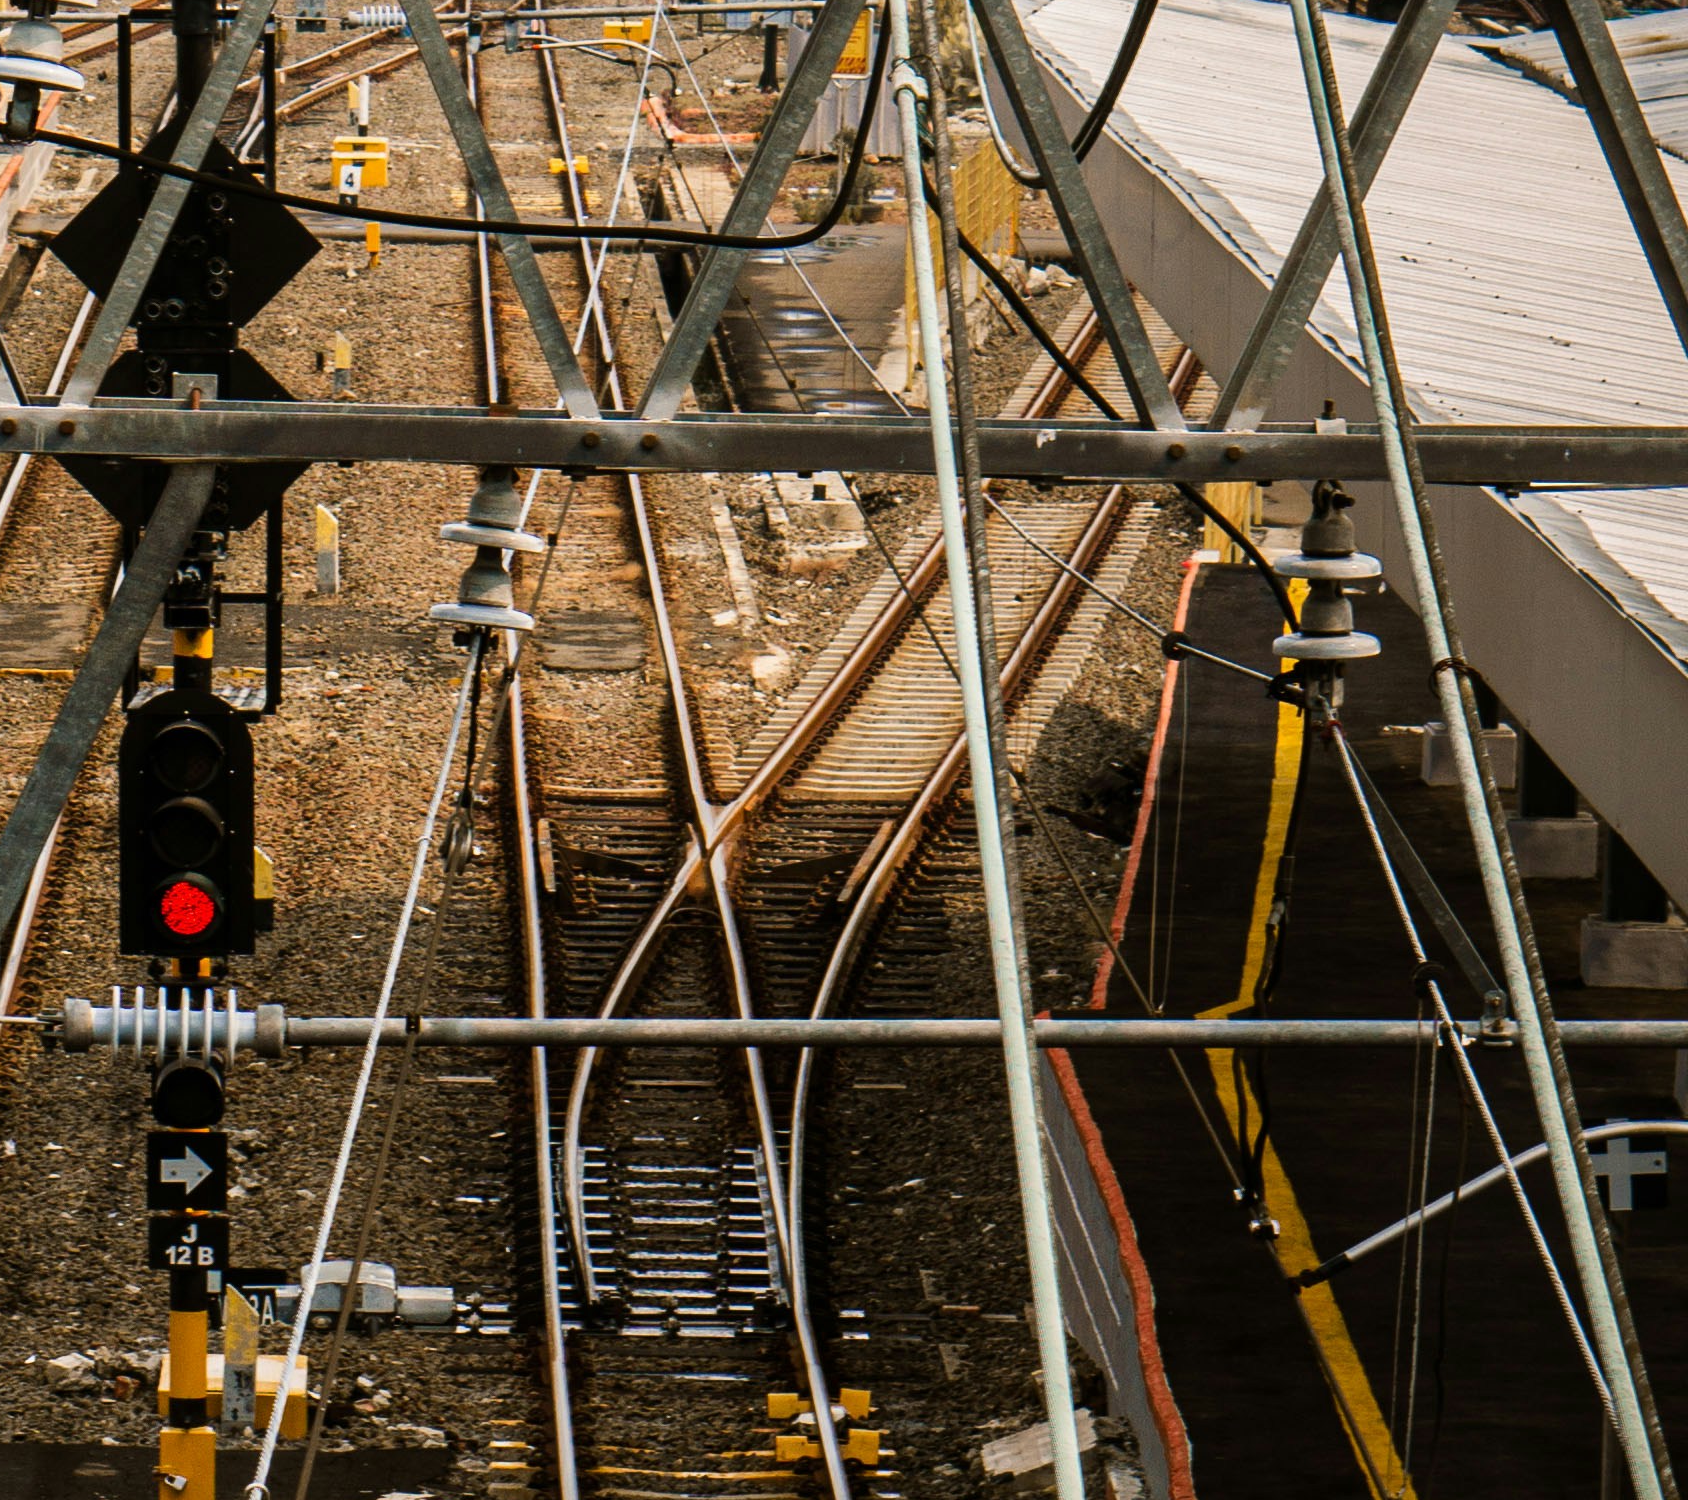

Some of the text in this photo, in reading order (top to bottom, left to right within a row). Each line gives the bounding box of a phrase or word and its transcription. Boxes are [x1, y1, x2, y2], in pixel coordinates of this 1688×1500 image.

[345, 172, 354, 187] 4
[181, 1224, 199, 1244] J
[165, 1246, 215, 1265] 12 B
